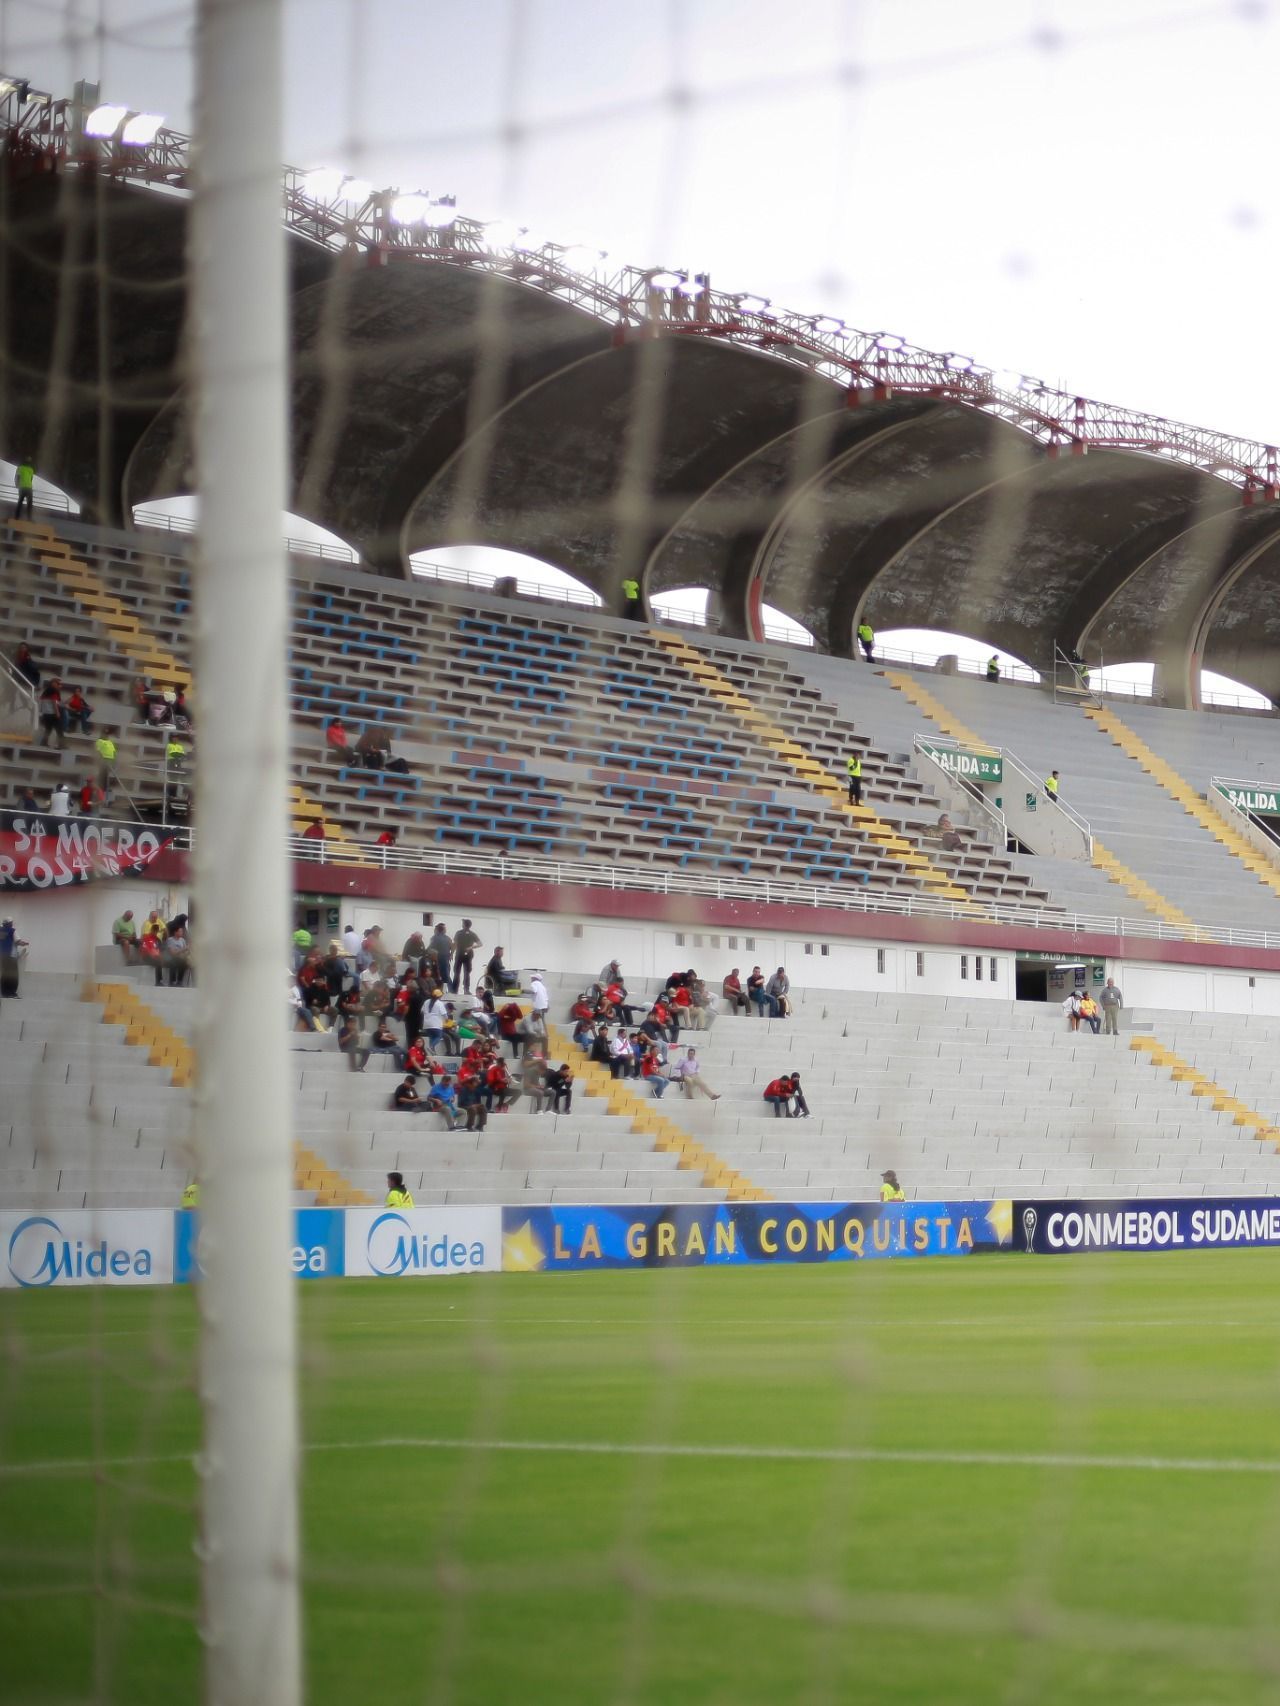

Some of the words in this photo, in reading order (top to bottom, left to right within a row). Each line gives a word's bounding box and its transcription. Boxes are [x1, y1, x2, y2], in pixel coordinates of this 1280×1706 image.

[931, 751, 980, 775] SALIDA
[1228, 790, 1278, 811] SALIDA
[1040, 952, 1067, 961] SALIDA
[553, 1222, 602, 1260] LA
[626, 1219, 737, 1258] GRAN
[759, 1217, 975, 1258] CONQUISTA
[1047, 1209, 1185, 1248] CONMEBOL
[31, 1240, 152, 1280] Midea
[385, 1234, 485, 1270] Midea
